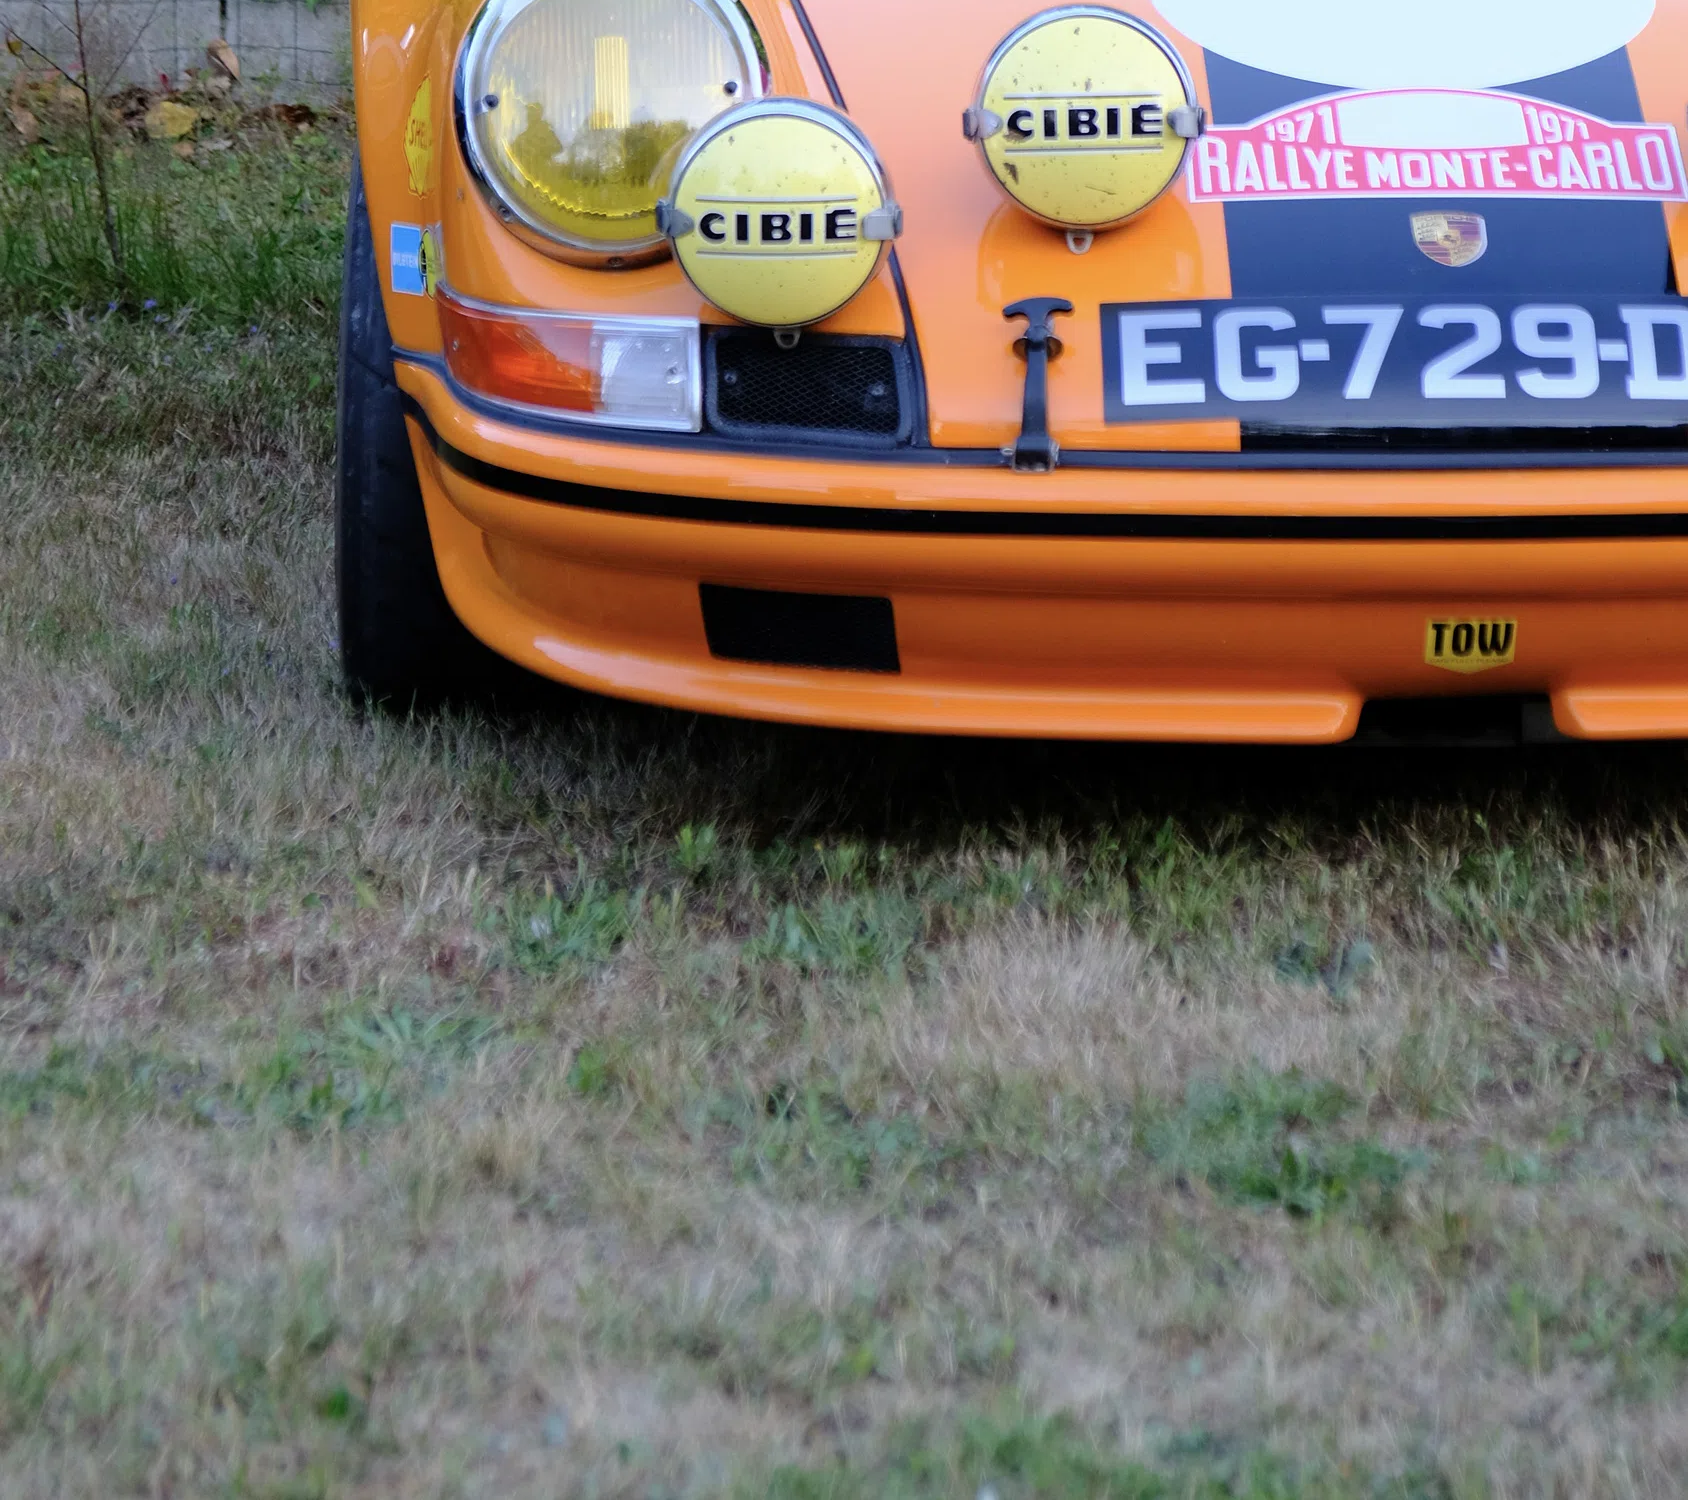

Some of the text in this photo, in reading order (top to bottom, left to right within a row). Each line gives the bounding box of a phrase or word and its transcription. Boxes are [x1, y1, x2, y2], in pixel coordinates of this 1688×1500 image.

[1265, 103, 1591, 148] 1971 1971
[1200, 132, 1677, 194] RALLYE MONTE-CARLO
[1119, 303, 1688, 406] EG-729-D
[1431, 622, 1515, 657] TOW
